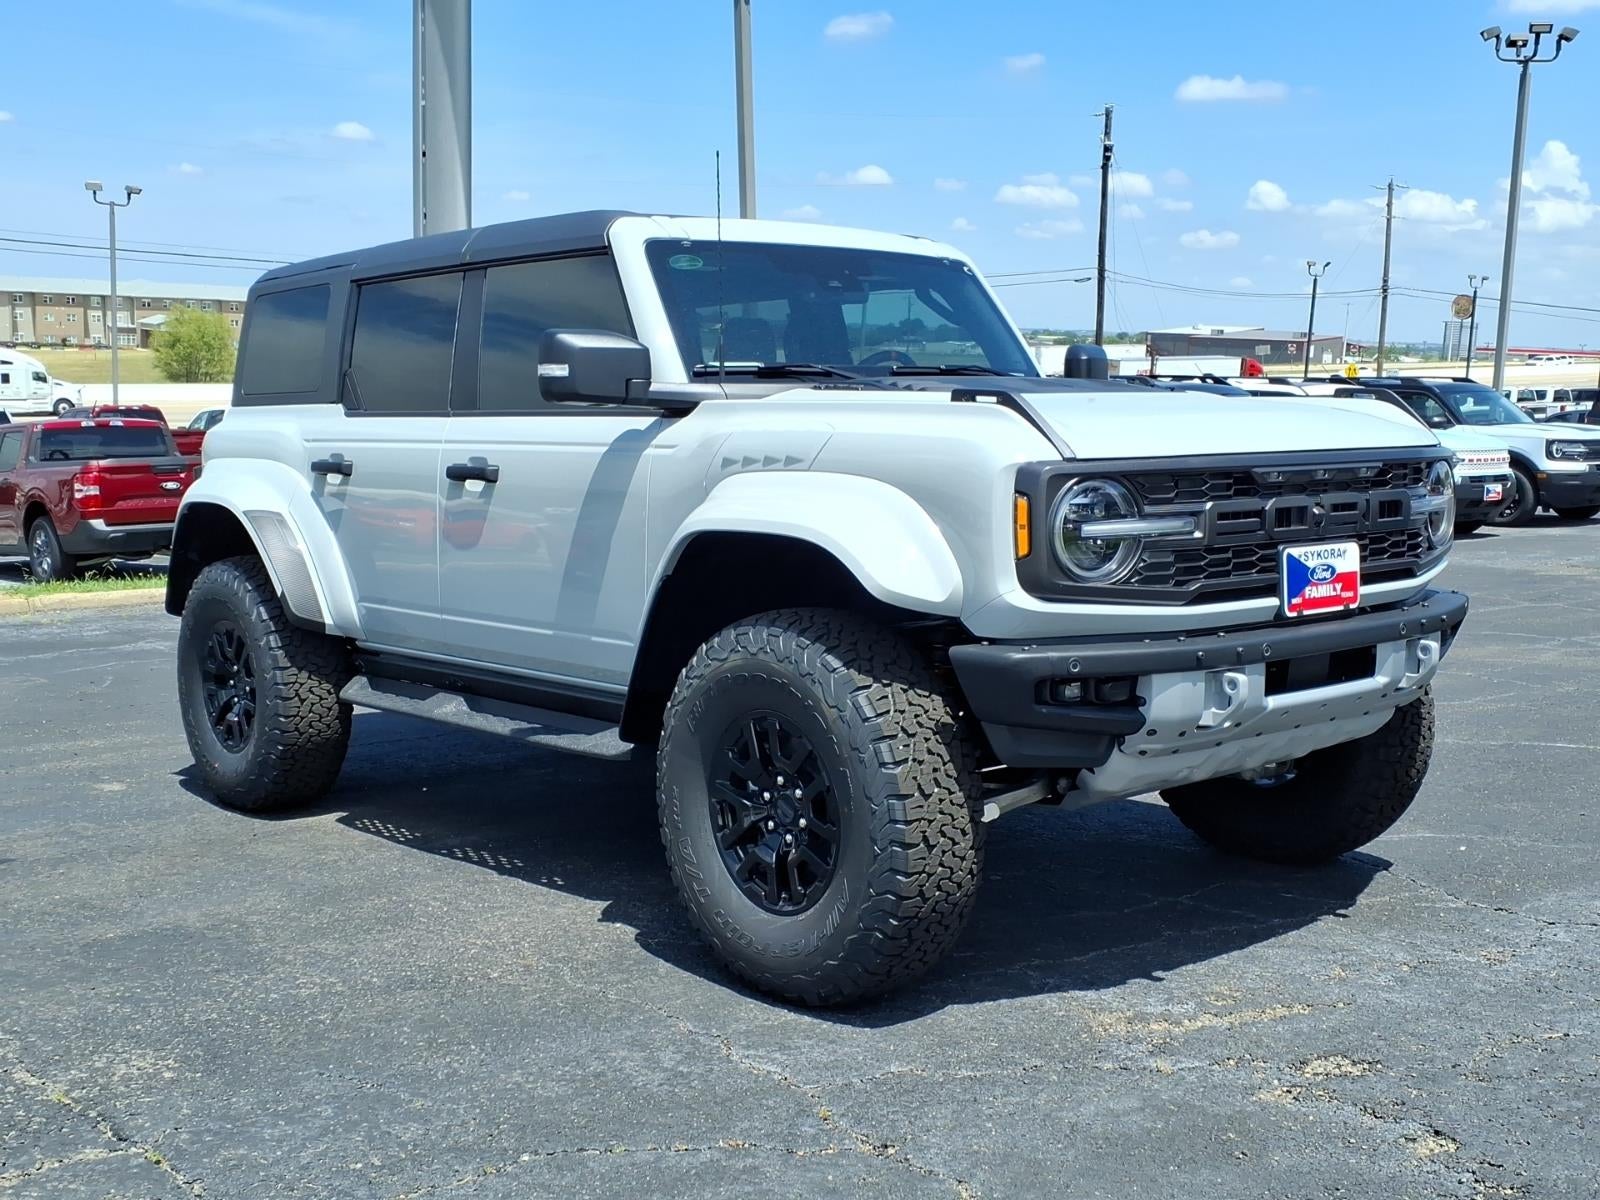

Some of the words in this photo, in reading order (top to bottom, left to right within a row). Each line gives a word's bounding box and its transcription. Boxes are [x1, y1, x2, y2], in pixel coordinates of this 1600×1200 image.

[1205, 489, 1412, 545] FORD
[1303, 548, 1342, 562] SYKORA
[1313, 565, 1332, 580] Ford
[1305, 583, 1343, 599] FAMILY
